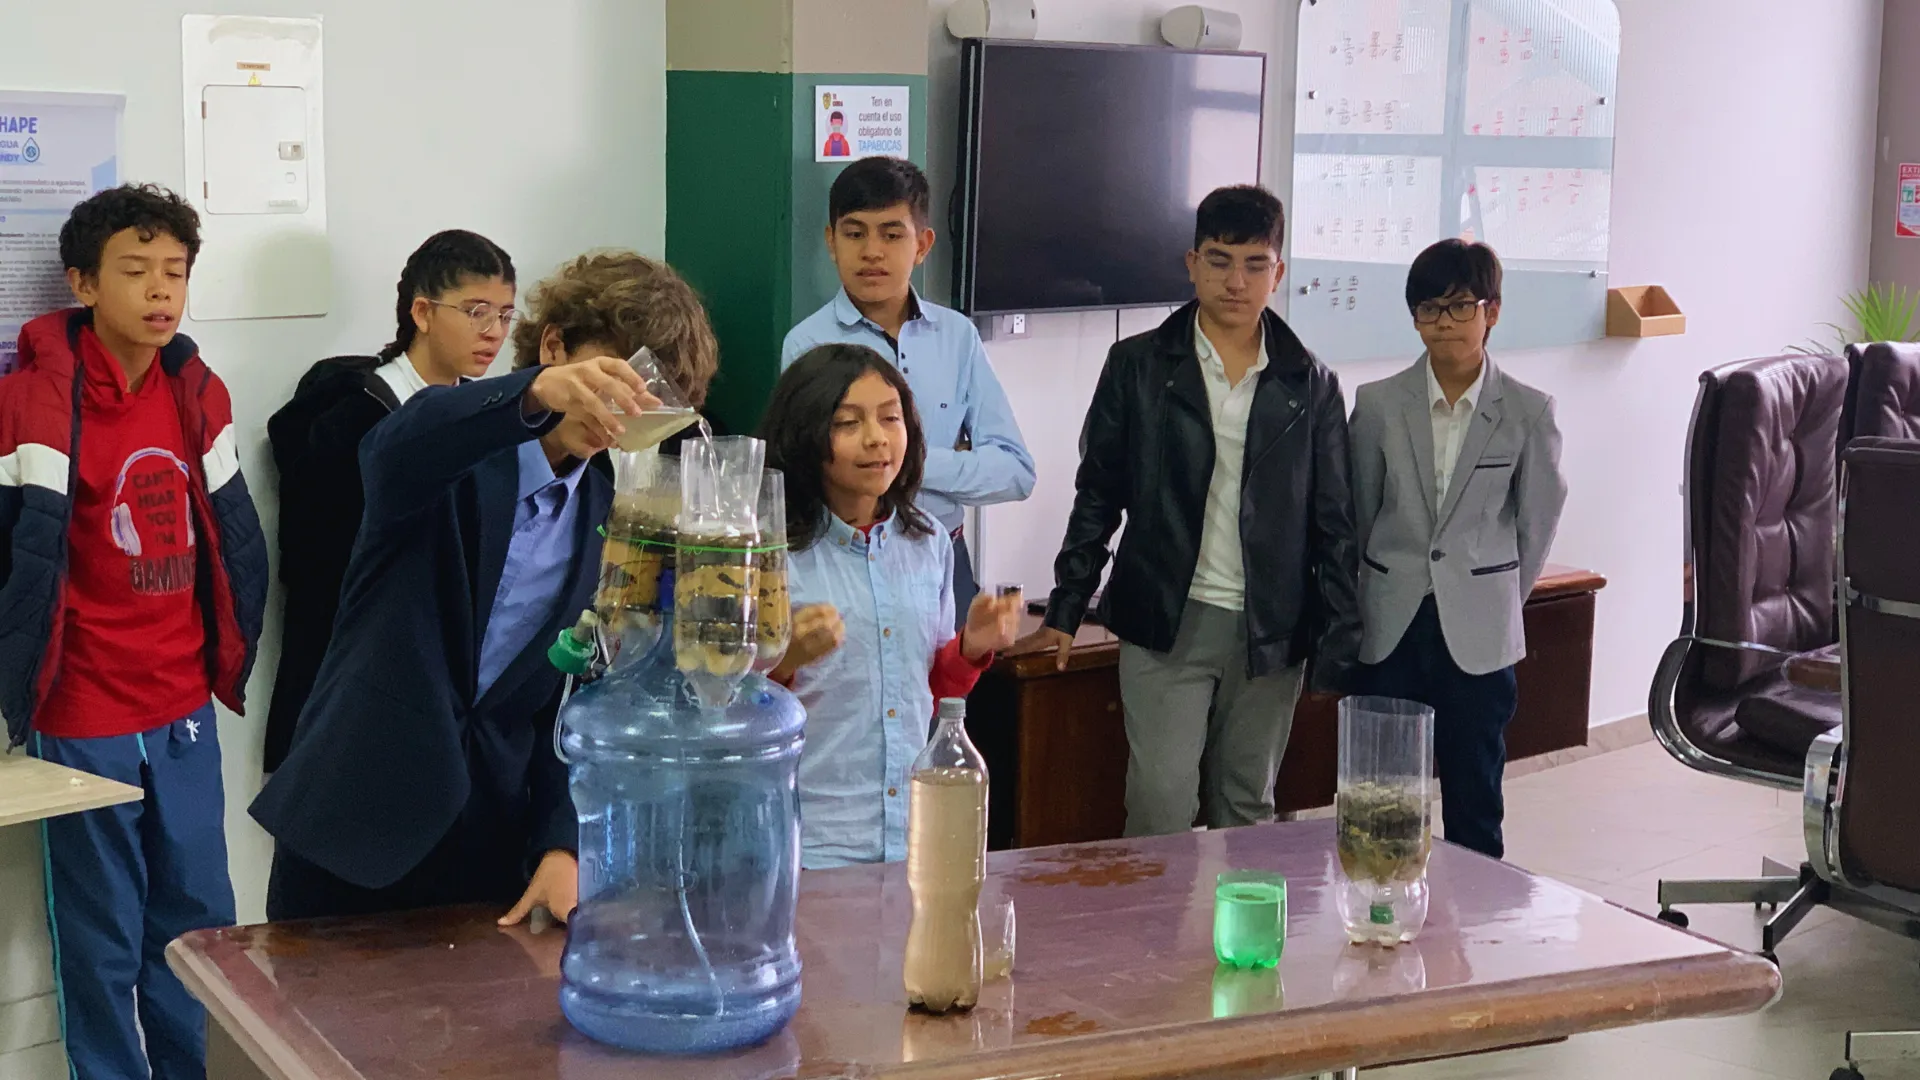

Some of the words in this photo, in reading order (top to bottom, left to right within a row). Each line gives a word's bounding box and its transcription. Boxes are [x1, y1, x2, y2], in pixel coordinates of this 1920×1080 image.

[871, 96, 882, 107] Ten
[884, 98, 893, 107] en
[859, 112, 881, 122] cuenta
[882, 111, 889, 121] el
[890, 113, 902, 121] uso
[858, 126, 892, 138] obligatorio
[893, 126, 902, 136] de
[858, 140, 902, 152] TAPABOCAS
[132, 470, 175, 489] CAN'T
[138, 491, 176, 509] HEAR
[147, 511, 176, 525] YOU
